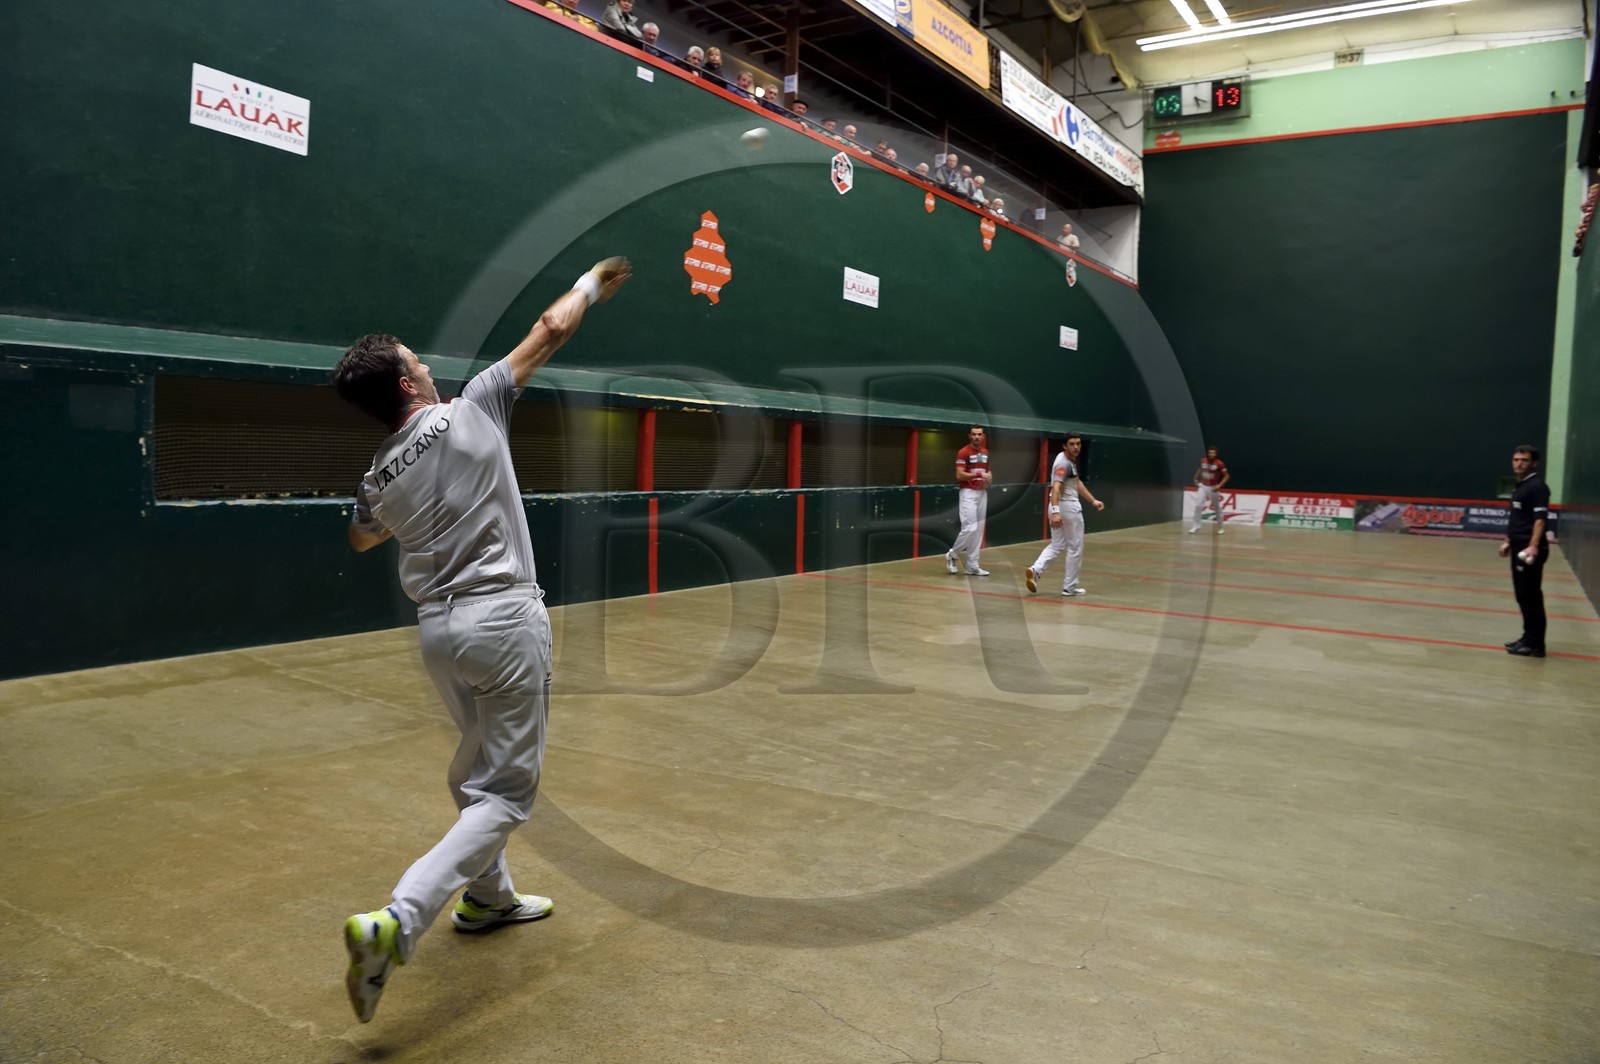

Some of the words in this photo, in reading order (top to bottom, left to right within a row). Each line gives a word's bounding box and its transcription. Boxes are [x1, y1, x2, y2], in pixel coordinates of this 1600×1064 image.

[931, 17, 972, 56] AZCOITIA
[1216, 87, 1240, 107] 13
[195, 88, 305, 137] LAUAK
[845, 281, 877, 297] LAUAK
[374, 417, 450, 493] LAZCANO
[1293, 506, 1340, 516] GARAZI
